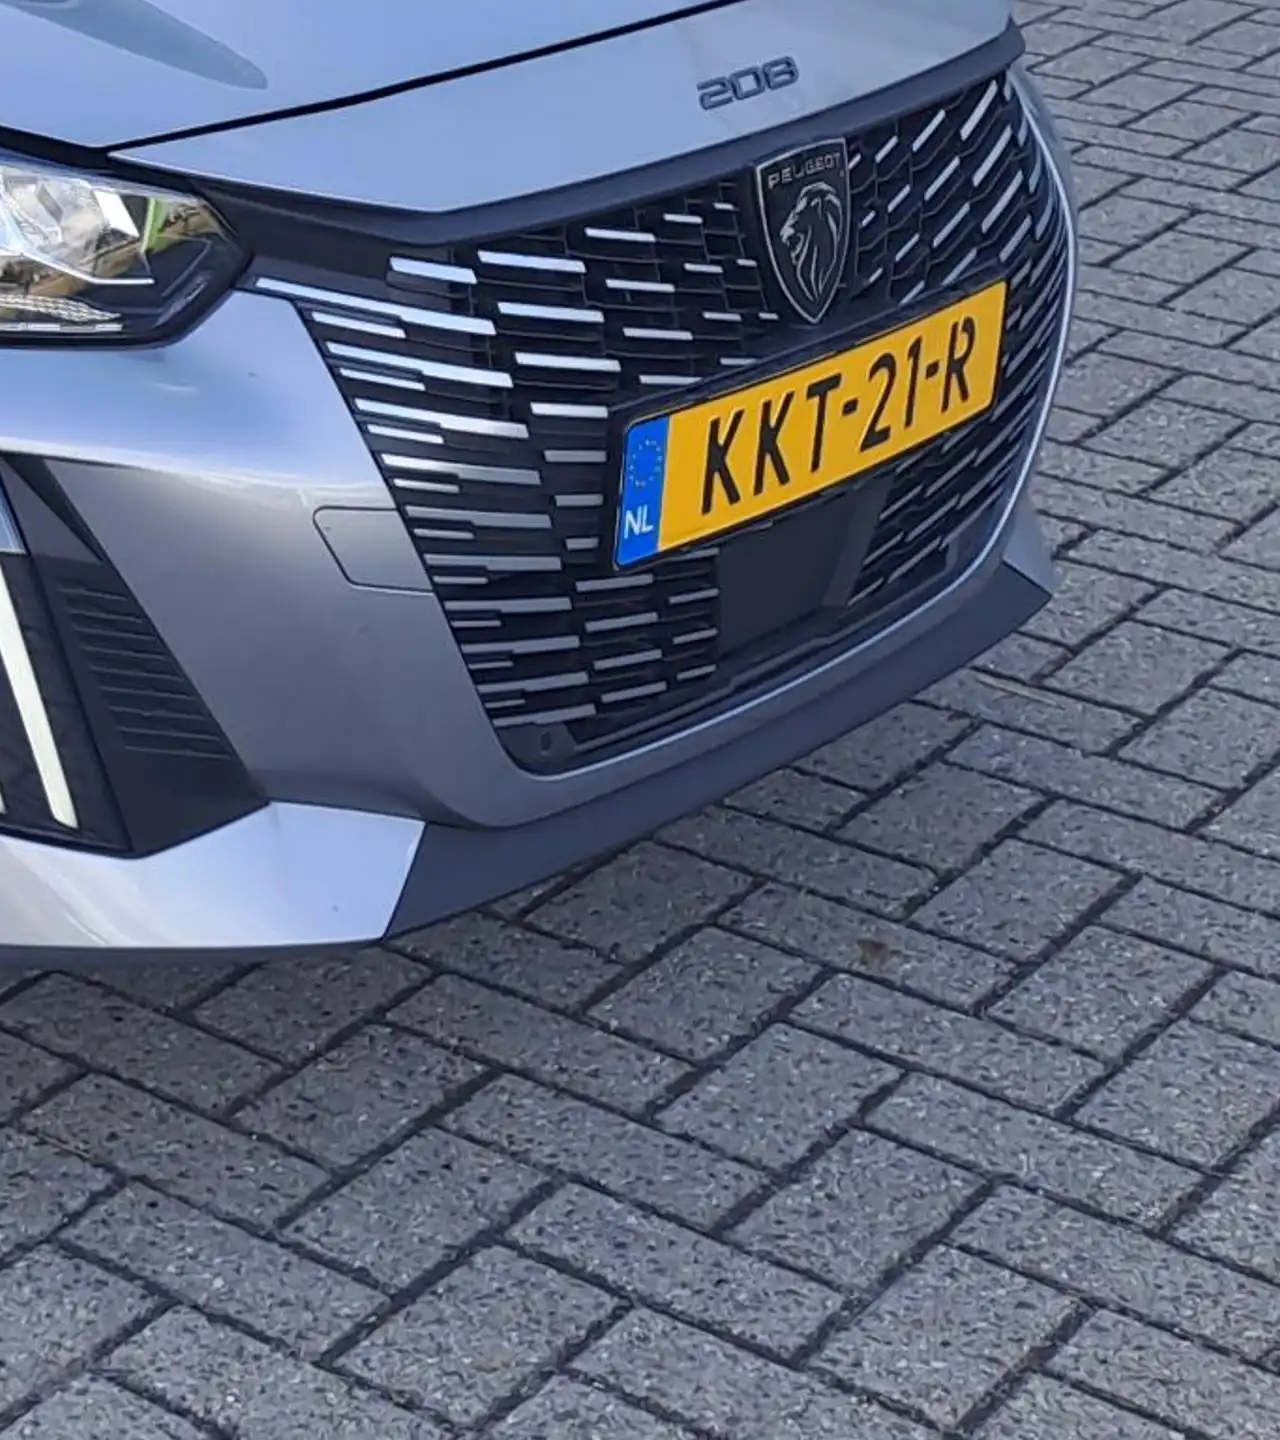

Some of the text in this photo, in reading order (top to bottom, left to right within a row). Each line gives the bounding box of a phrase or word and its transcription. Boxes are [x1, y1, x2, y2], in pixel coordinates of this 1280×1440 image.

[696, 56, 799, 110] 208
[767, 152, 842, 189] PEUGEOT
[701, 316, 976, 516] KKT-21-R
[623, 504, 654, 539] NL
